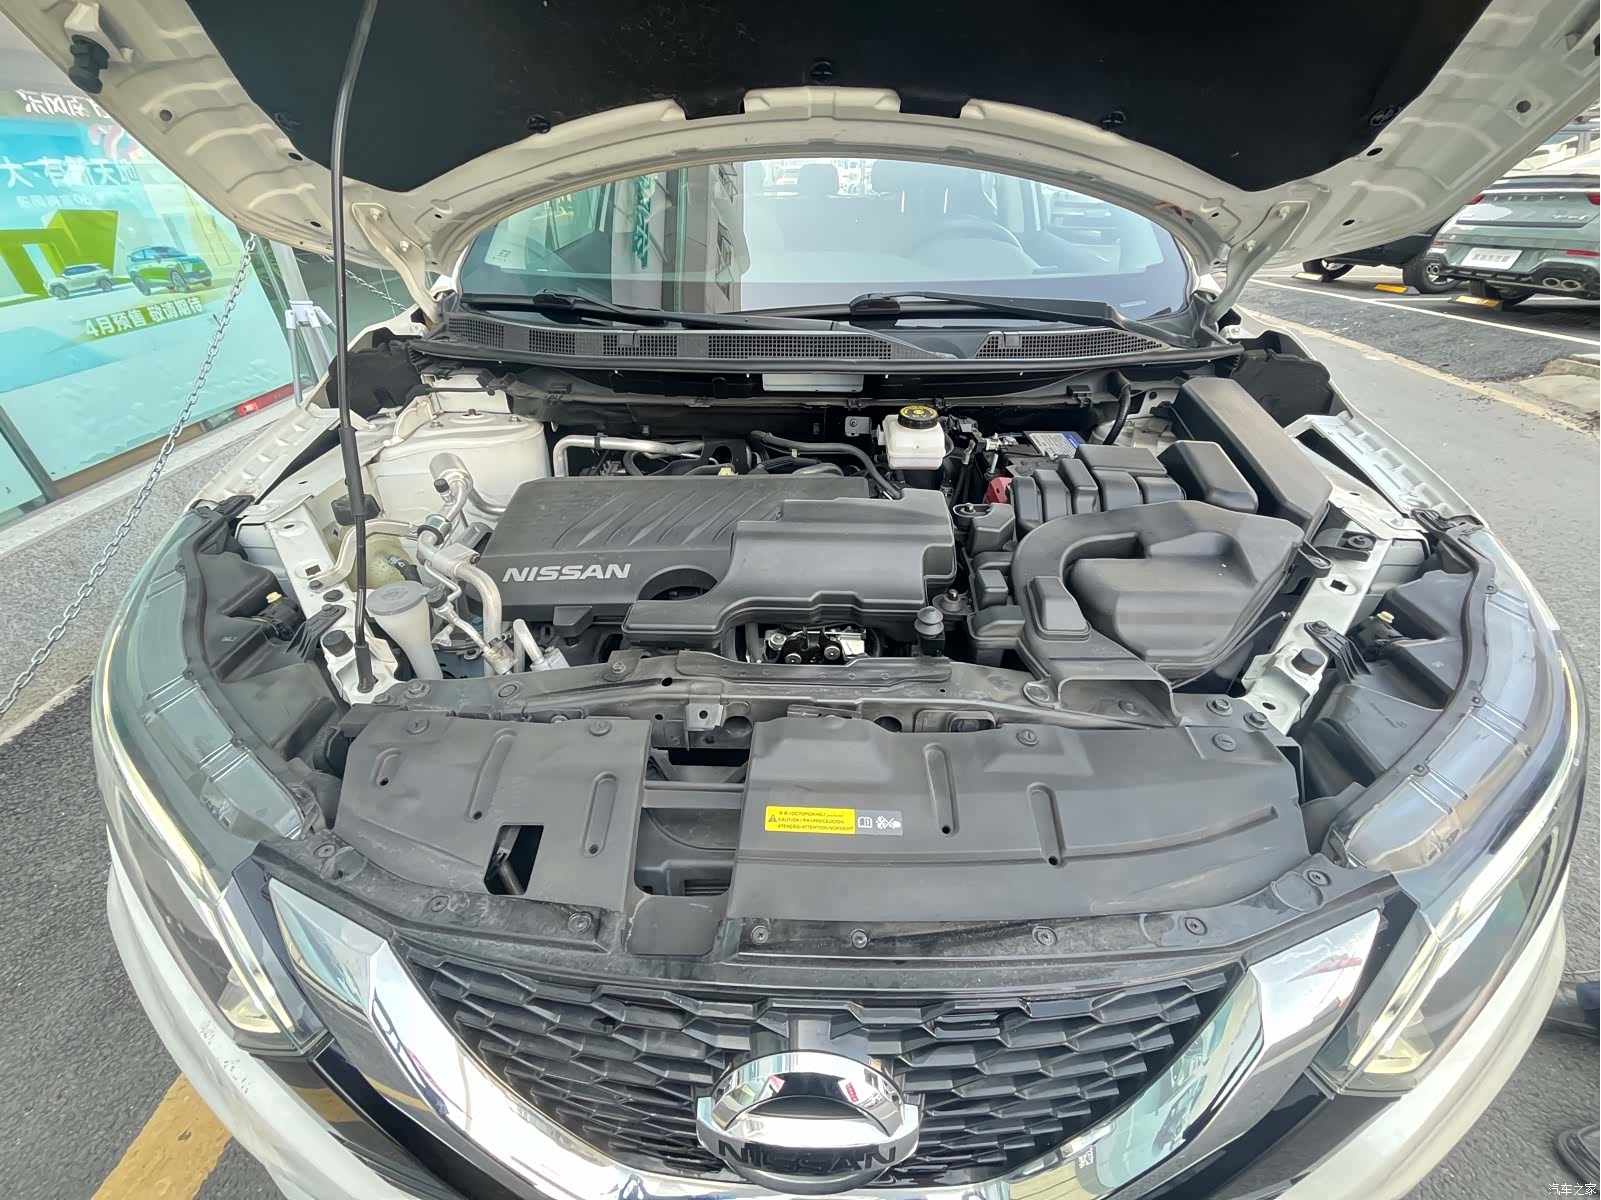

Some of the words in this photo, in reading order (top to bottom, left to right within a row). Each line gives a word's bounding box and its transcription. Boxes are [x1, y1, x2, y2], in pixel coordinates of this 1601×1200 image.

[86, 309, 146, 336] 4月预售
[147, 297, 202, 322] 敬请期待
[502, 563, 631, 582] NISSAN
[718, 1140, 897, 1176] NISSAN
